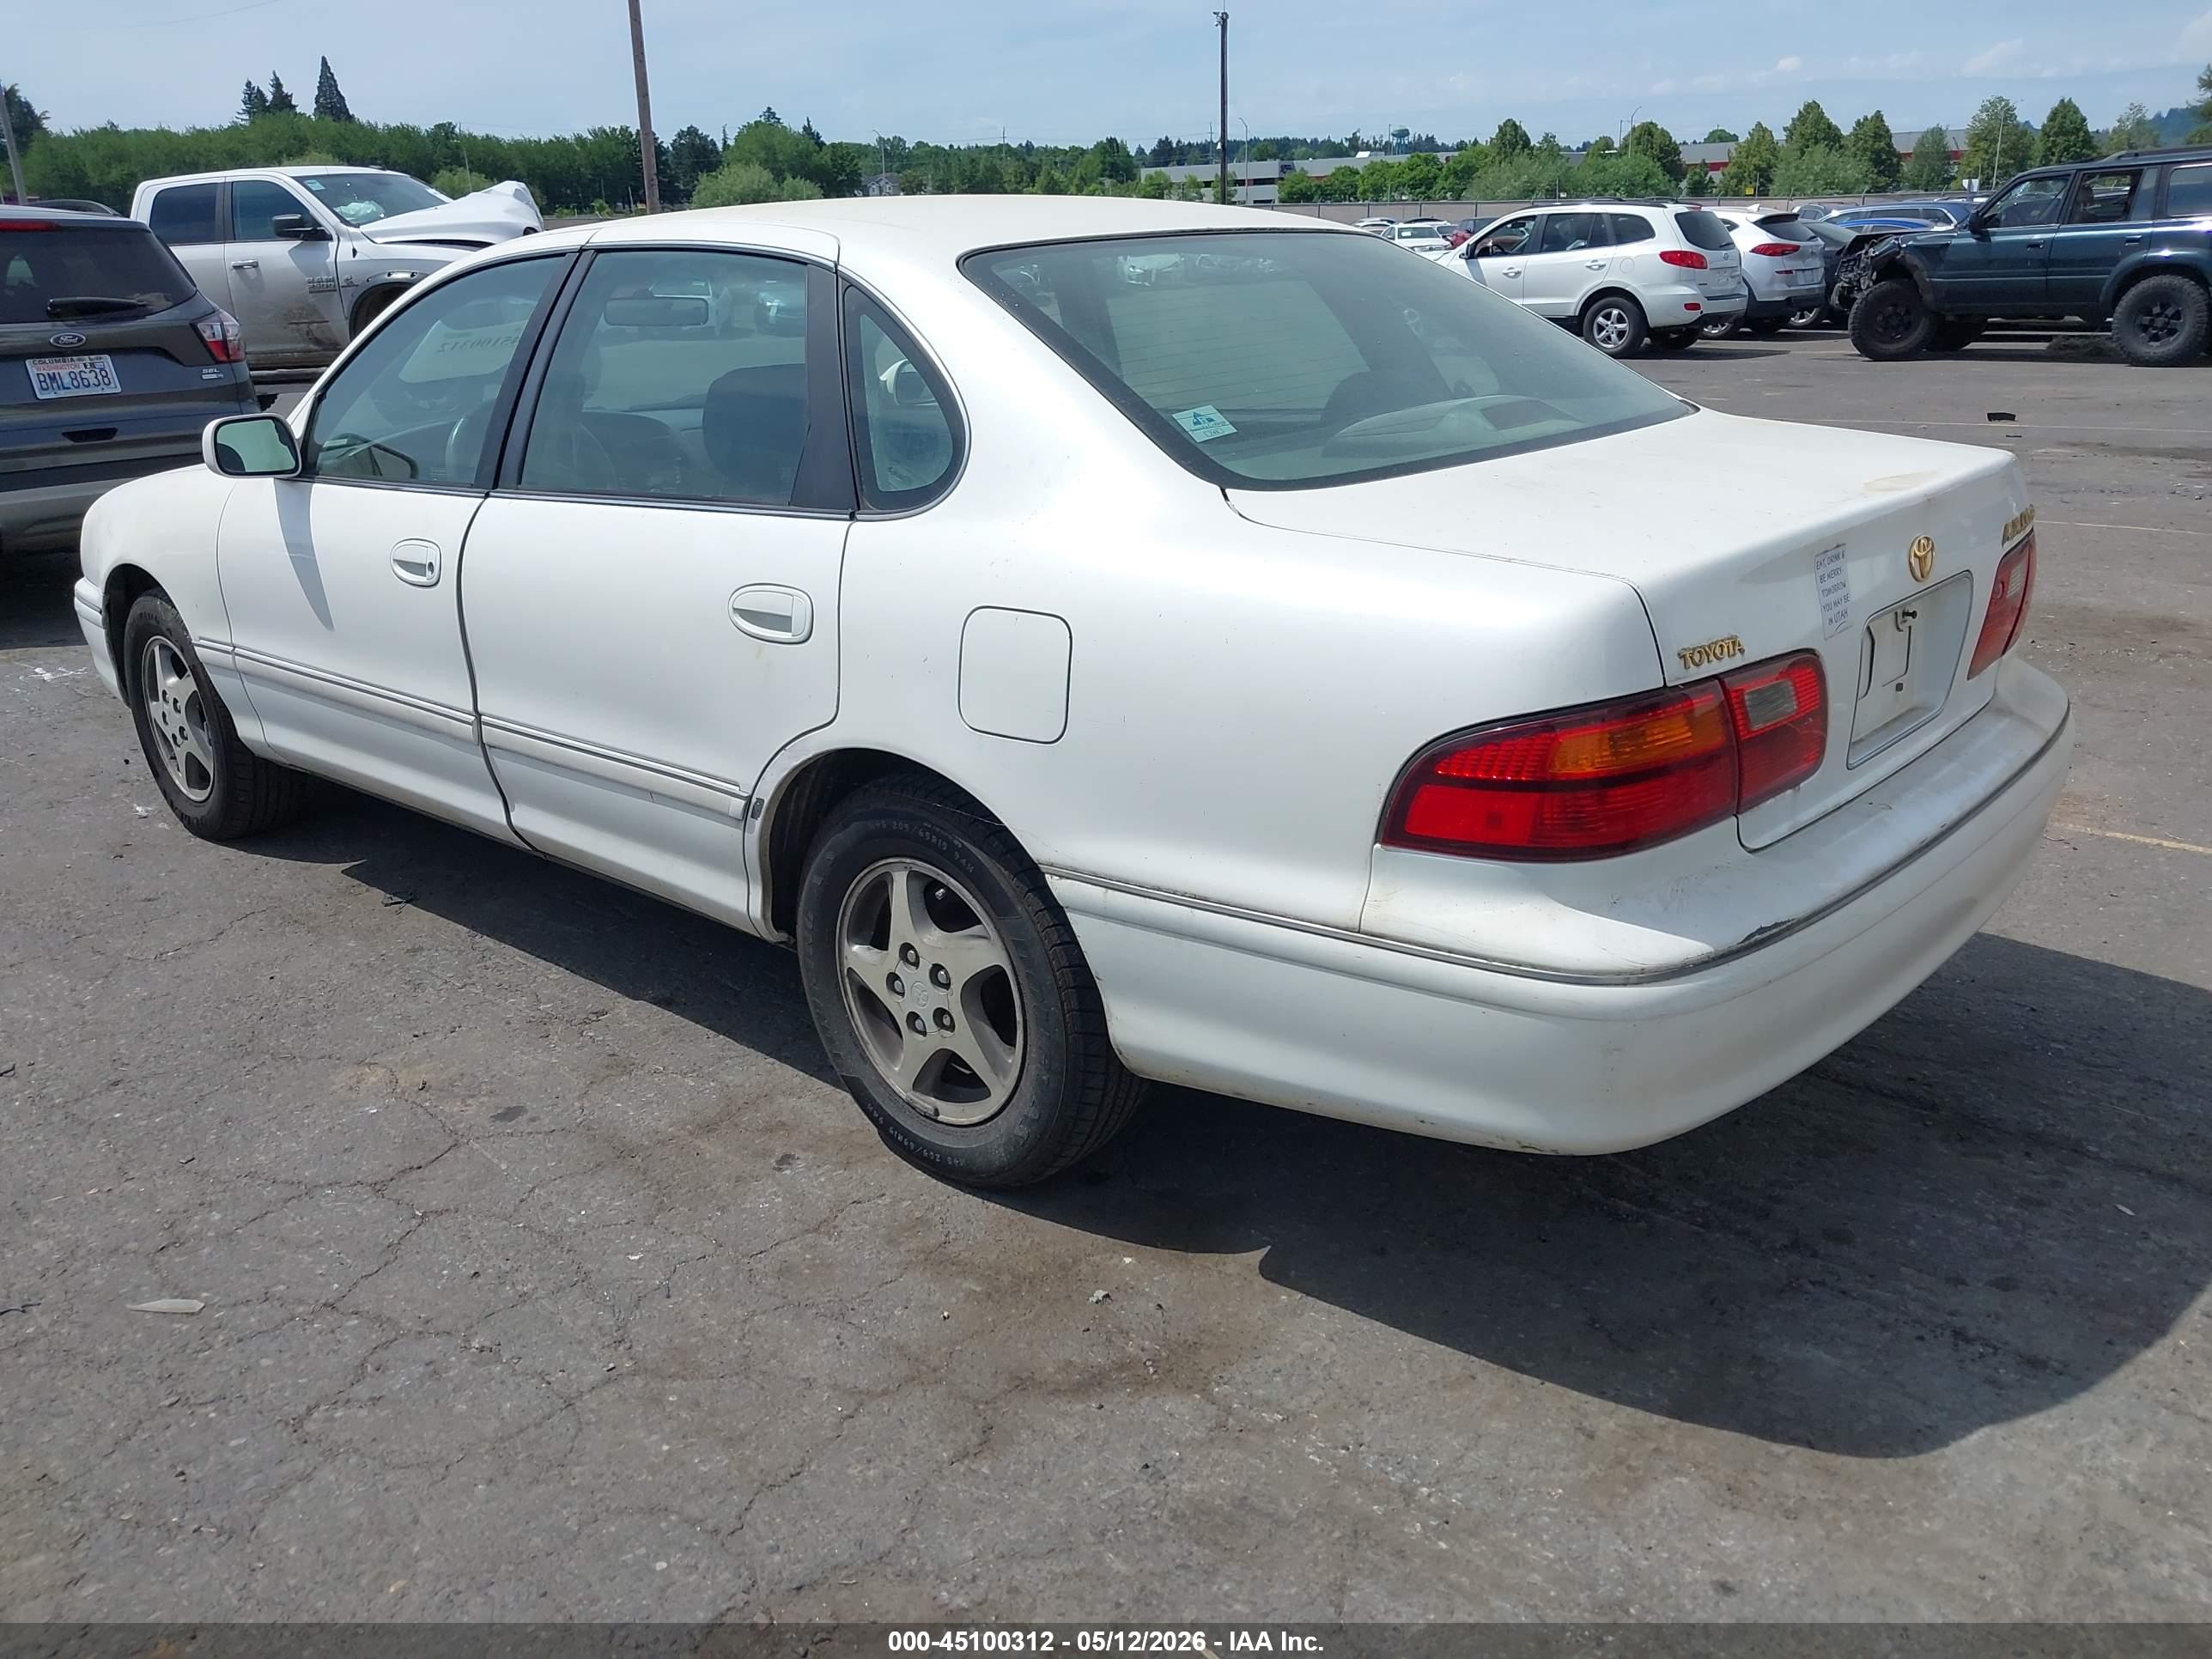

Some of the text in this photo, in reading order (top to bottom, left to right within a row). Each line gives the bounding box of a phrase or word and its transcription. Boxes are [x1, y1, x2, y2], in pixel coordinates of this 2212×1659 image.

[37, 369, 112, 391] BML8638
[1833, 606, 1848, 623] UTAH
[1677, 634, 1745, 670] TOYOTA
